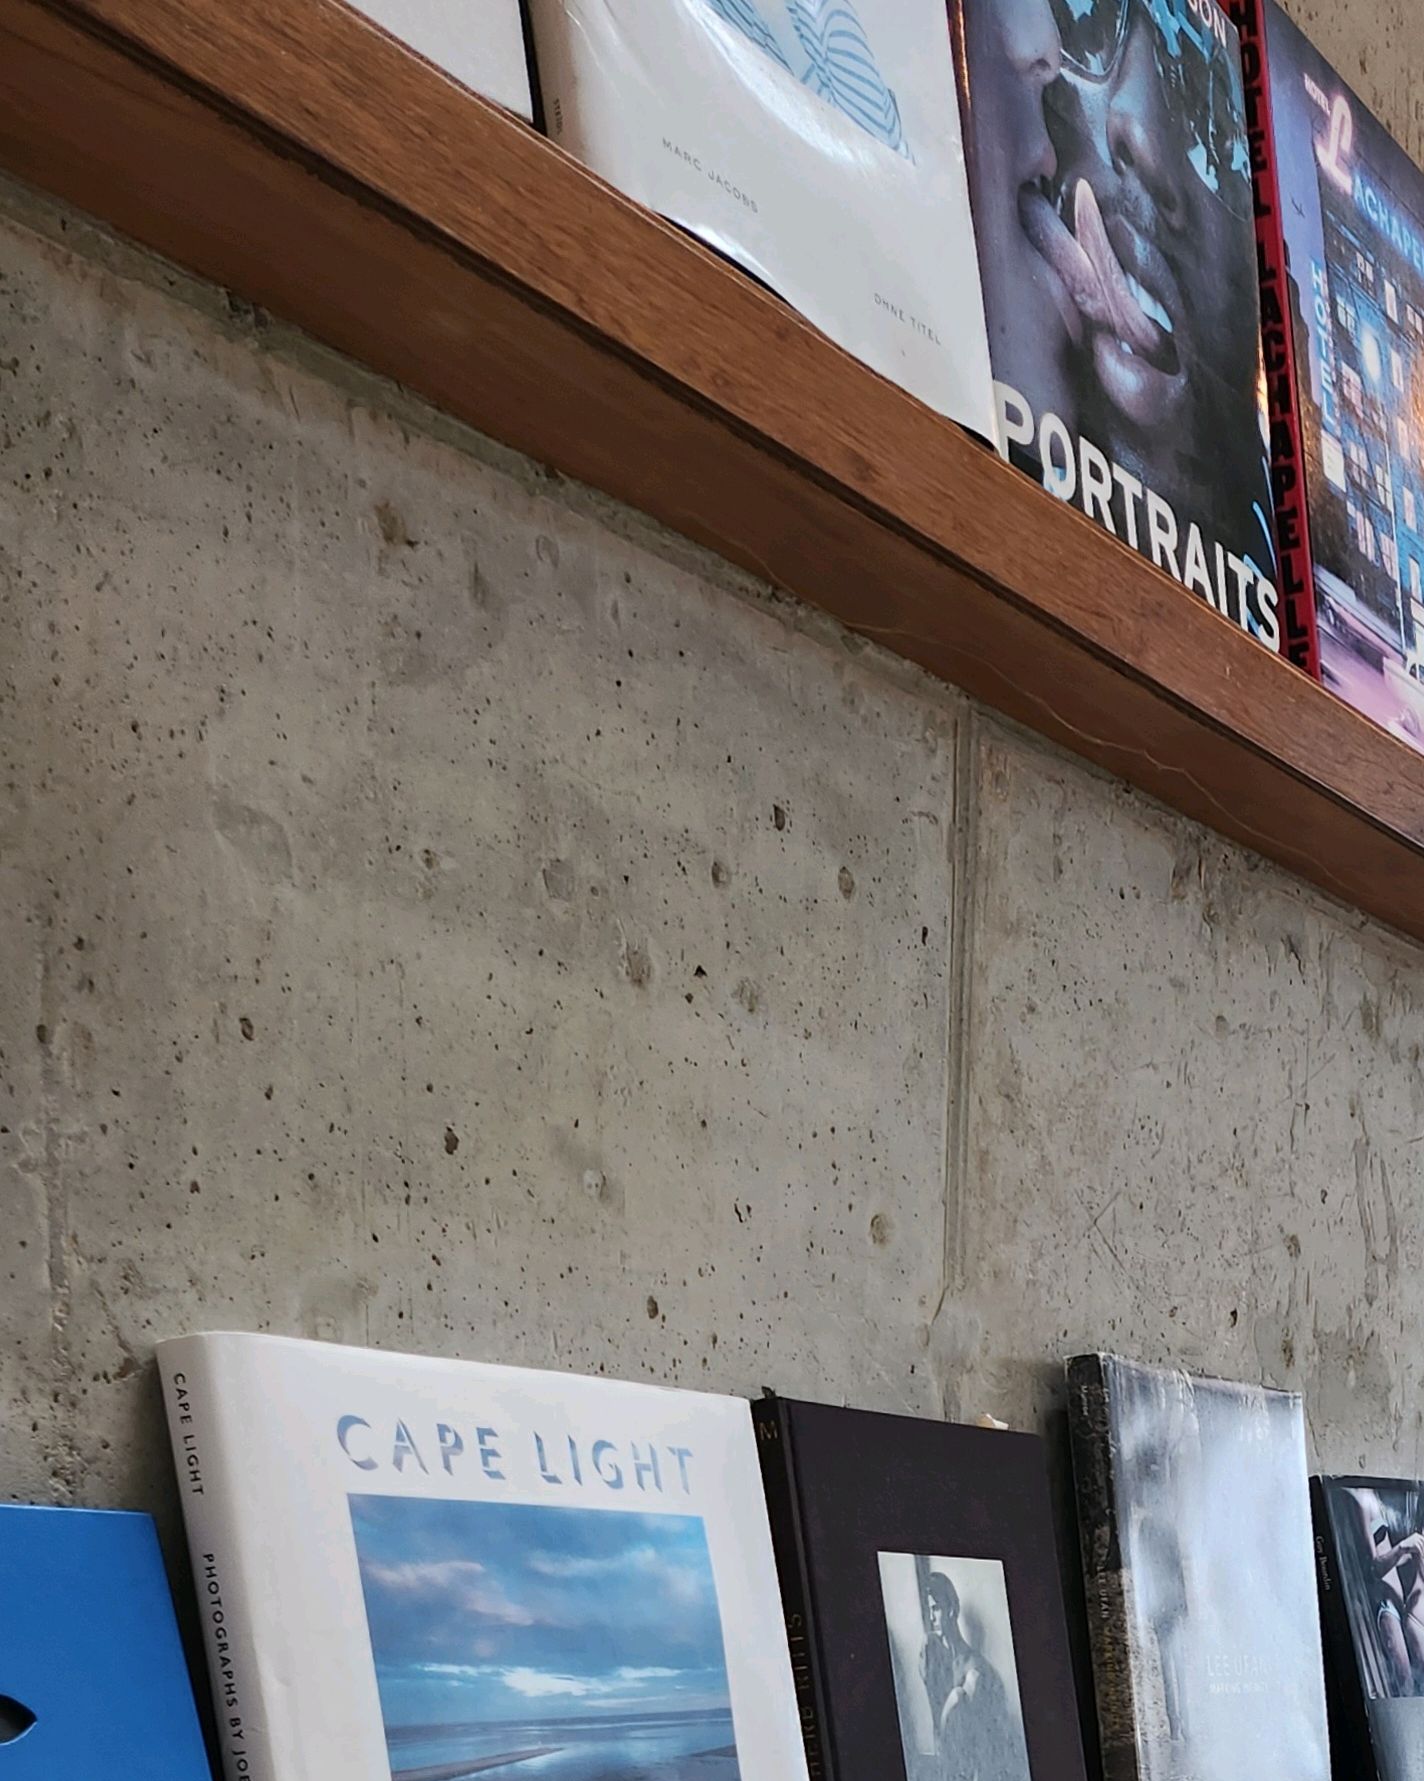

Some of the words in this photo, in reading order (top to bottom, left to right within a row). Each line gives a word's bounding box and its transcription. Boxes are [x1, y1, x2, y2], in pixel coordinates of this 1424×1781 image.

[662, 137, 703, 171] MARC
[708, 170, 758, 214] JACOBS
[910, 316, 941, 345] TITEL
[1311, 258, 1337, 427] HOTEL
[992, 379, 1281, 654] PORTRAITS
[337, 1414, 507, 1481] CAPE
[533, 1430, 695, 1496] LIGHT
[173, 1373, 193, 1424] CAPE
[184, 1434, 204, 1496] LIGHT
[202, 1552, 239, 1708] PHOTOGRAPHS
[228, 1717, 244, 1740] BY
